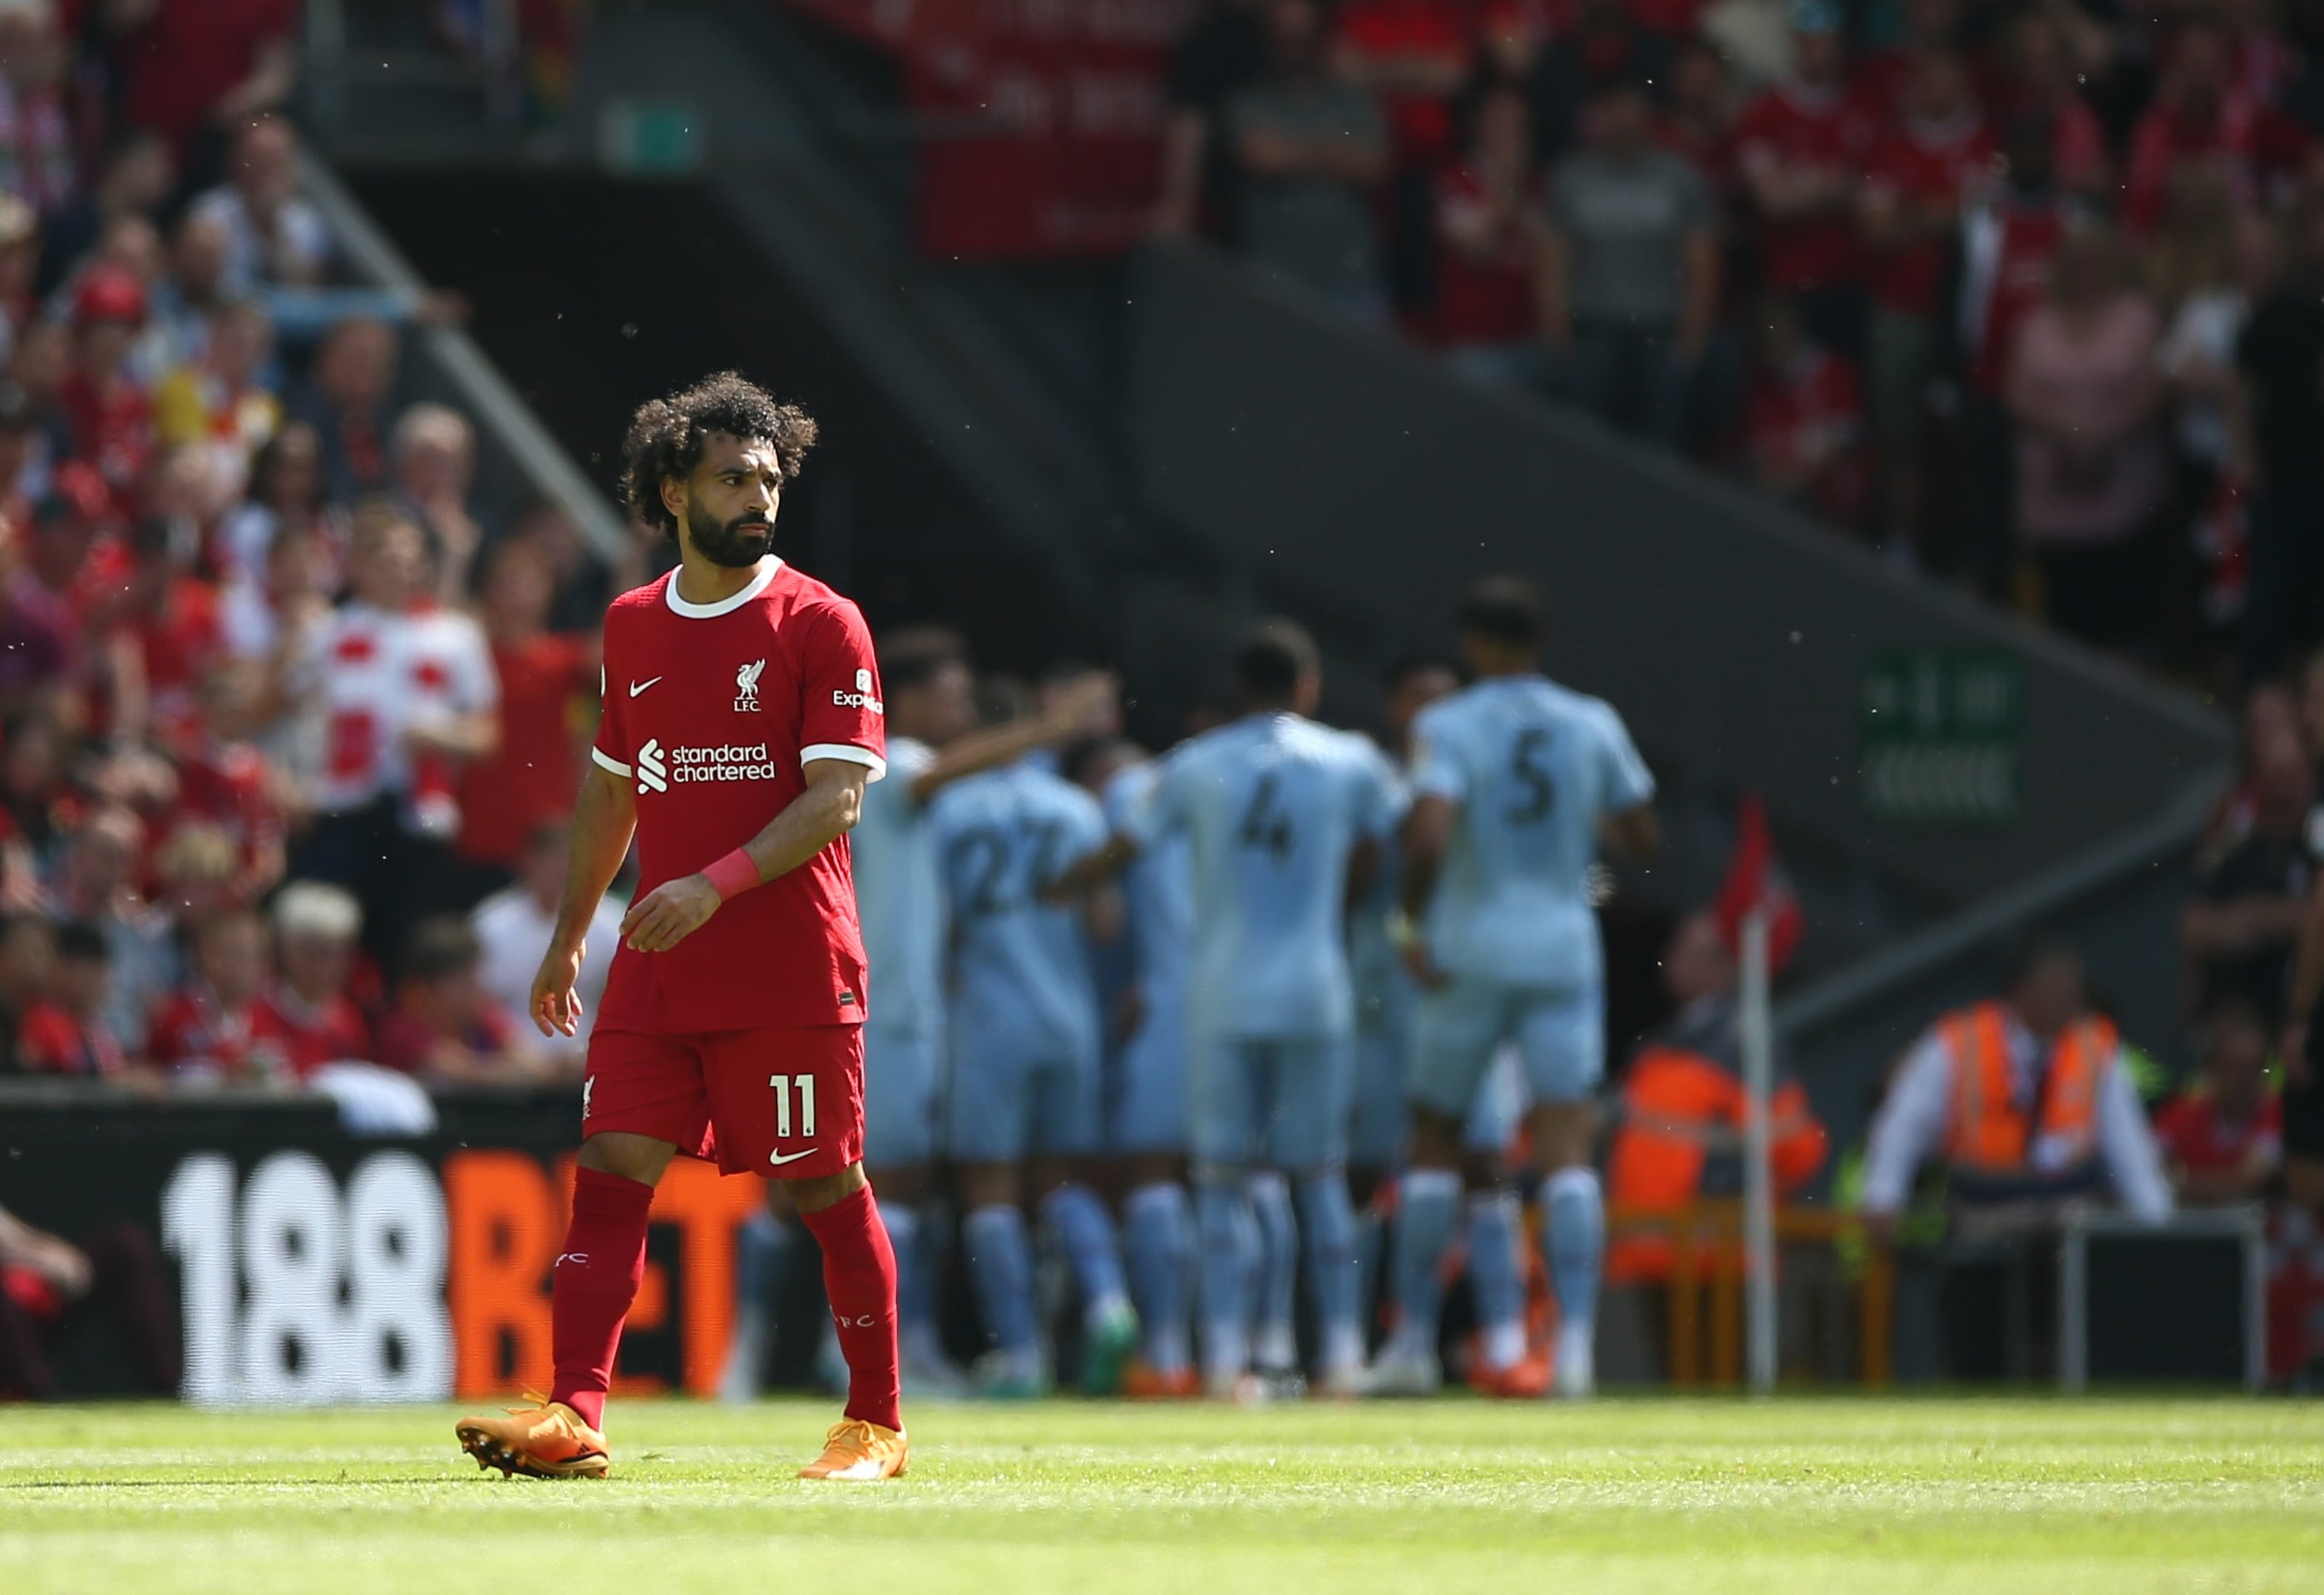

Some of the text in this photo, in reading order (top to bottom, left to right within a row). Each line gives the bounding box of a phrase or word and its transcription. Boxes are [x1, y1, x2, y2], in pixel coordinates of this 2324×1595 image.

[672, 743, 767, 764] standard
[674, 760, 775, 783] chartered
[1506, 729, 1554, 826] 5
[1237, 771, 1294, 862] 4
[769, 1074, 815, 1137] 11
